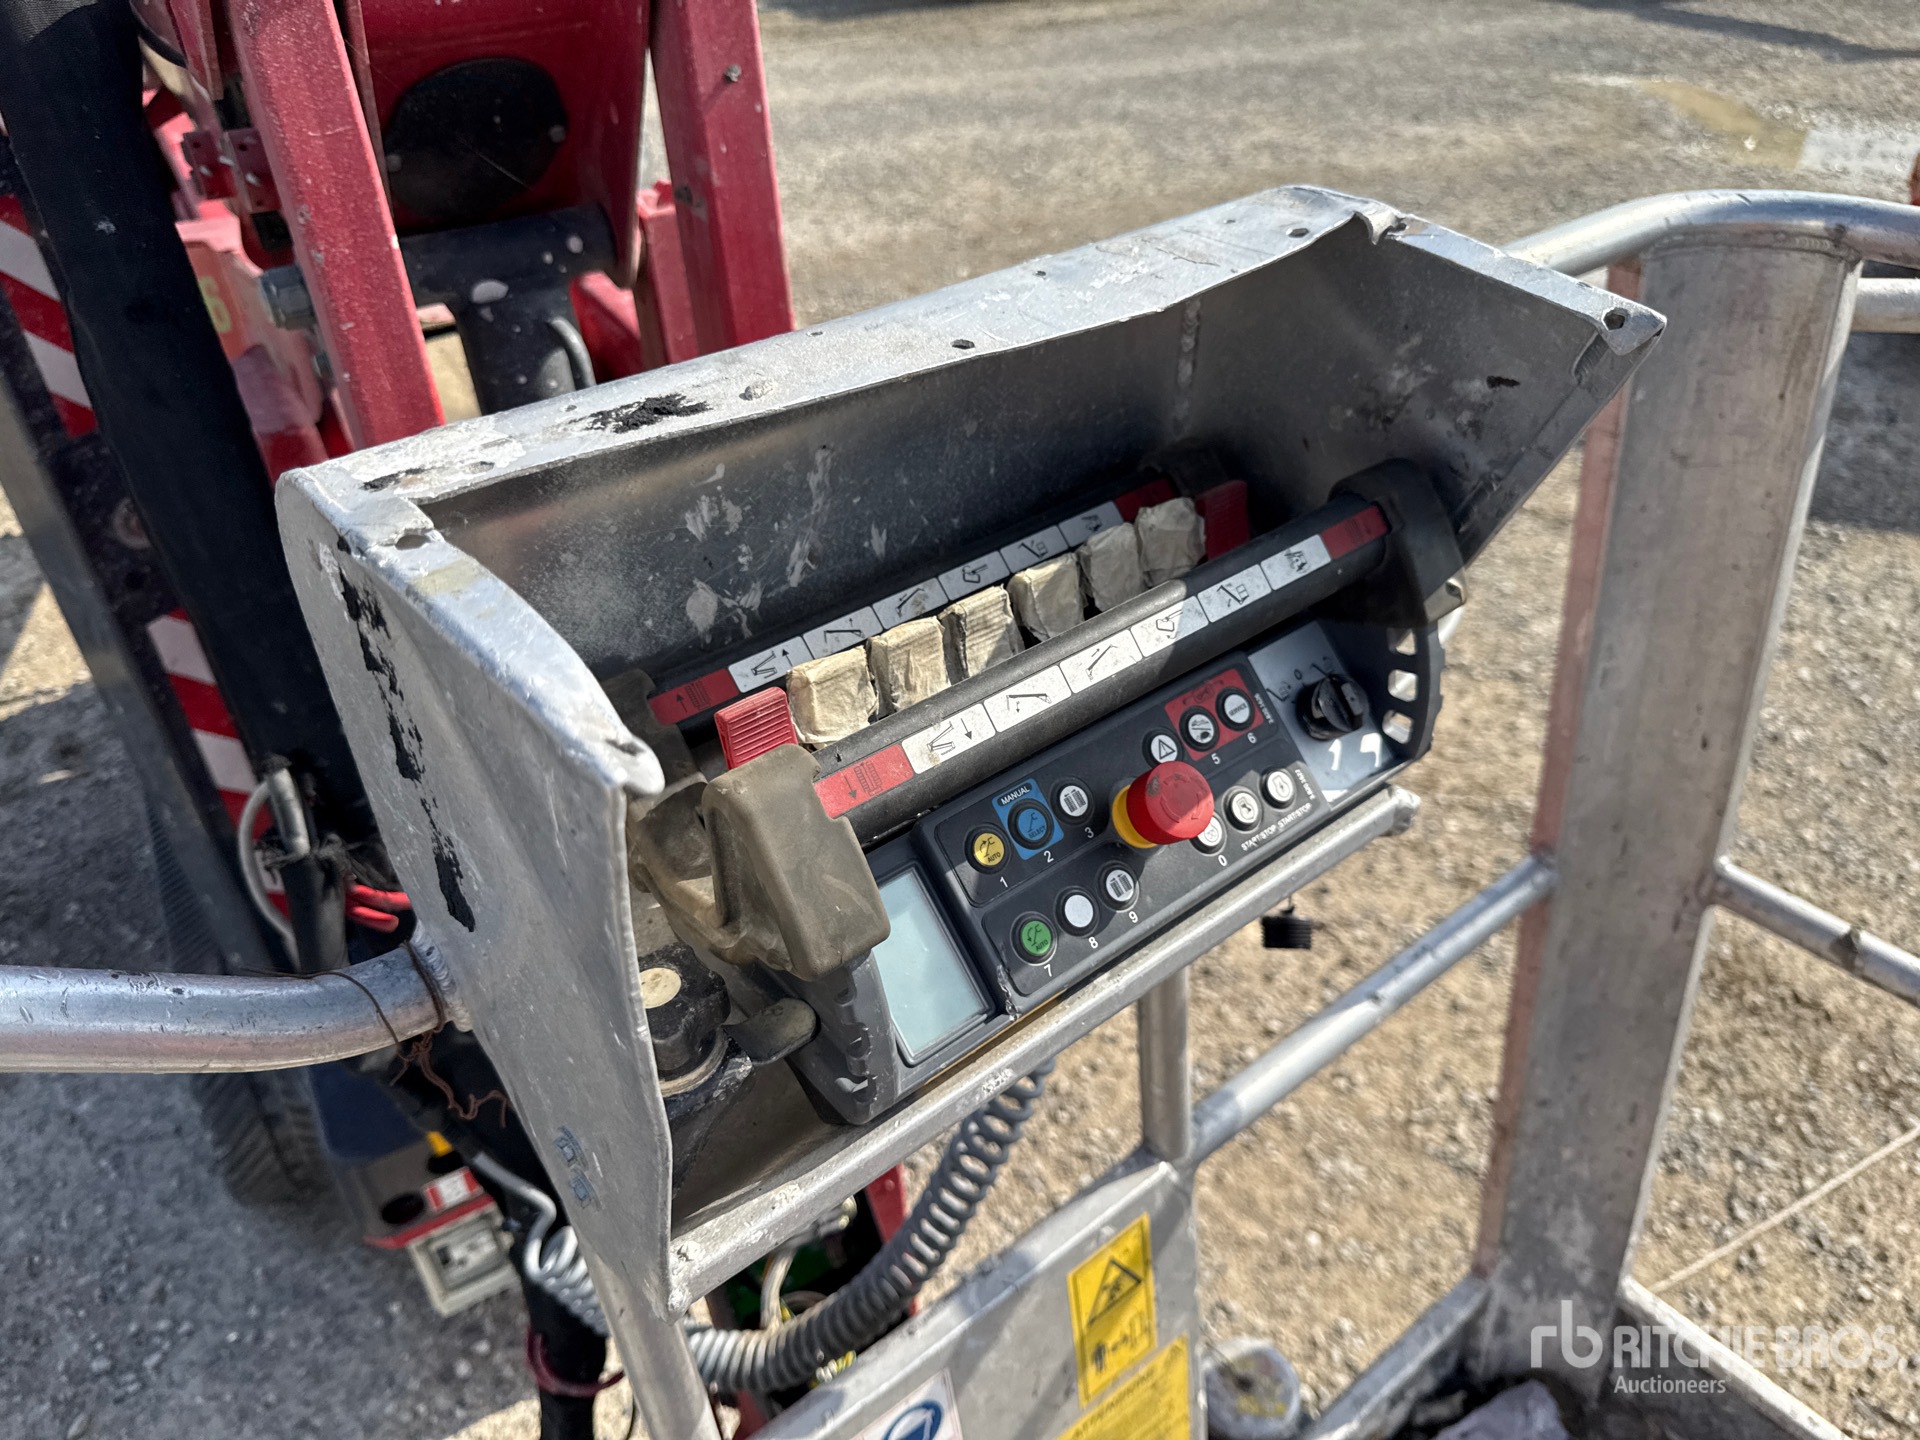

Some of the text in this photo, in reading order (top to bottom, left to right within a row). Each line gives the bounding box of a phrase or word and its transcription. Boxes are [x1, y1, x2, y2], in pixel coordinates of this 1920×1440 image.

[1228, 702, 1247, 717] SERVICE
[1247, 732, 1257, 744] 6
[1211, 752, 1221, 765] 5
[1000, 785, 1030, 805] MANUAL
[1028, 825, 1046, 839] SELECT
[1084, 826, 1094, 839] 3
[987, 852, 1001, 863] AUTO
[1043, 850, 1054, 863] 2
[1218, 854, 1227, 867] 0
[1000, 876, 1008, 888] 1
[1128, 911, 1138, 923] 9
[1035, 939, 1049, 952] AUTO
[1088, 936, 1099, 949] 8
[1043, 963, 1052, 977] 7
